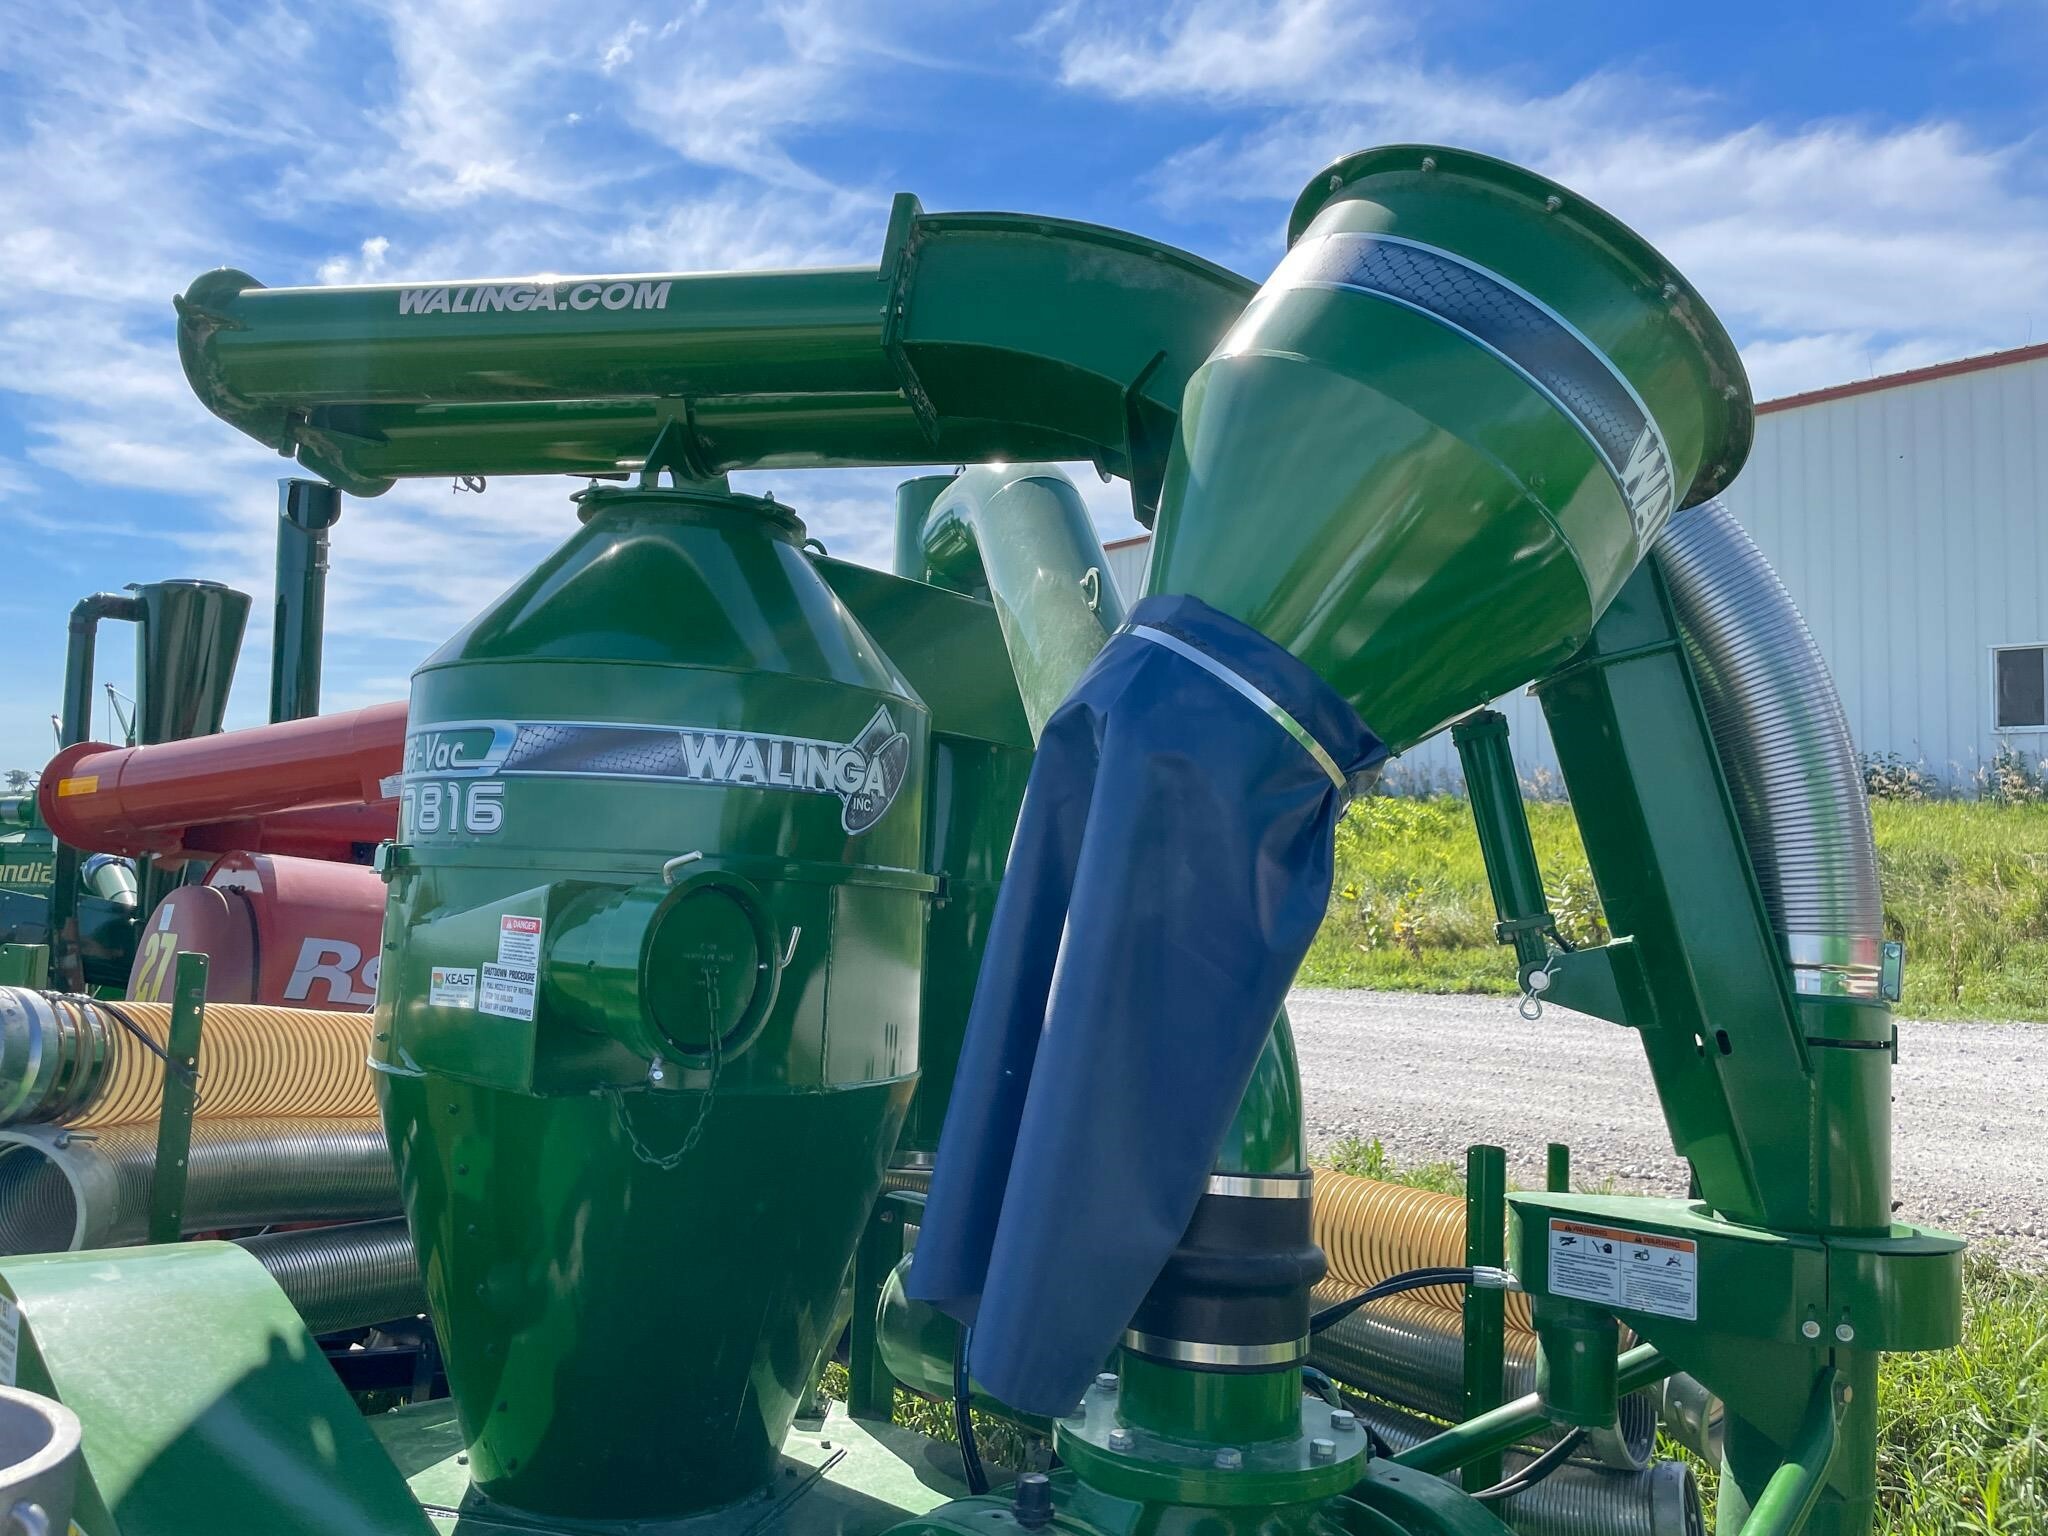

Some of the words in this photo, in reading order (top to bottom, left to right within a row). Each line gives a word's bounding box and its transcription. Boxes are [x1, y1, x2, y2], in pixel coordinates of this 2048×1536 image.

[680, 731, 887, 799] WALINGA
[852, 797, 875, 813] INC.
[513, 920, 537, 930] DANGER
[445, 973, 475, 986] KEAST
[509, 970, 536, 982] PROCEDURE
[1572, 1224, 1608, 1237] WARNING
[1643, 1236, 1681, 1249] WARNING
